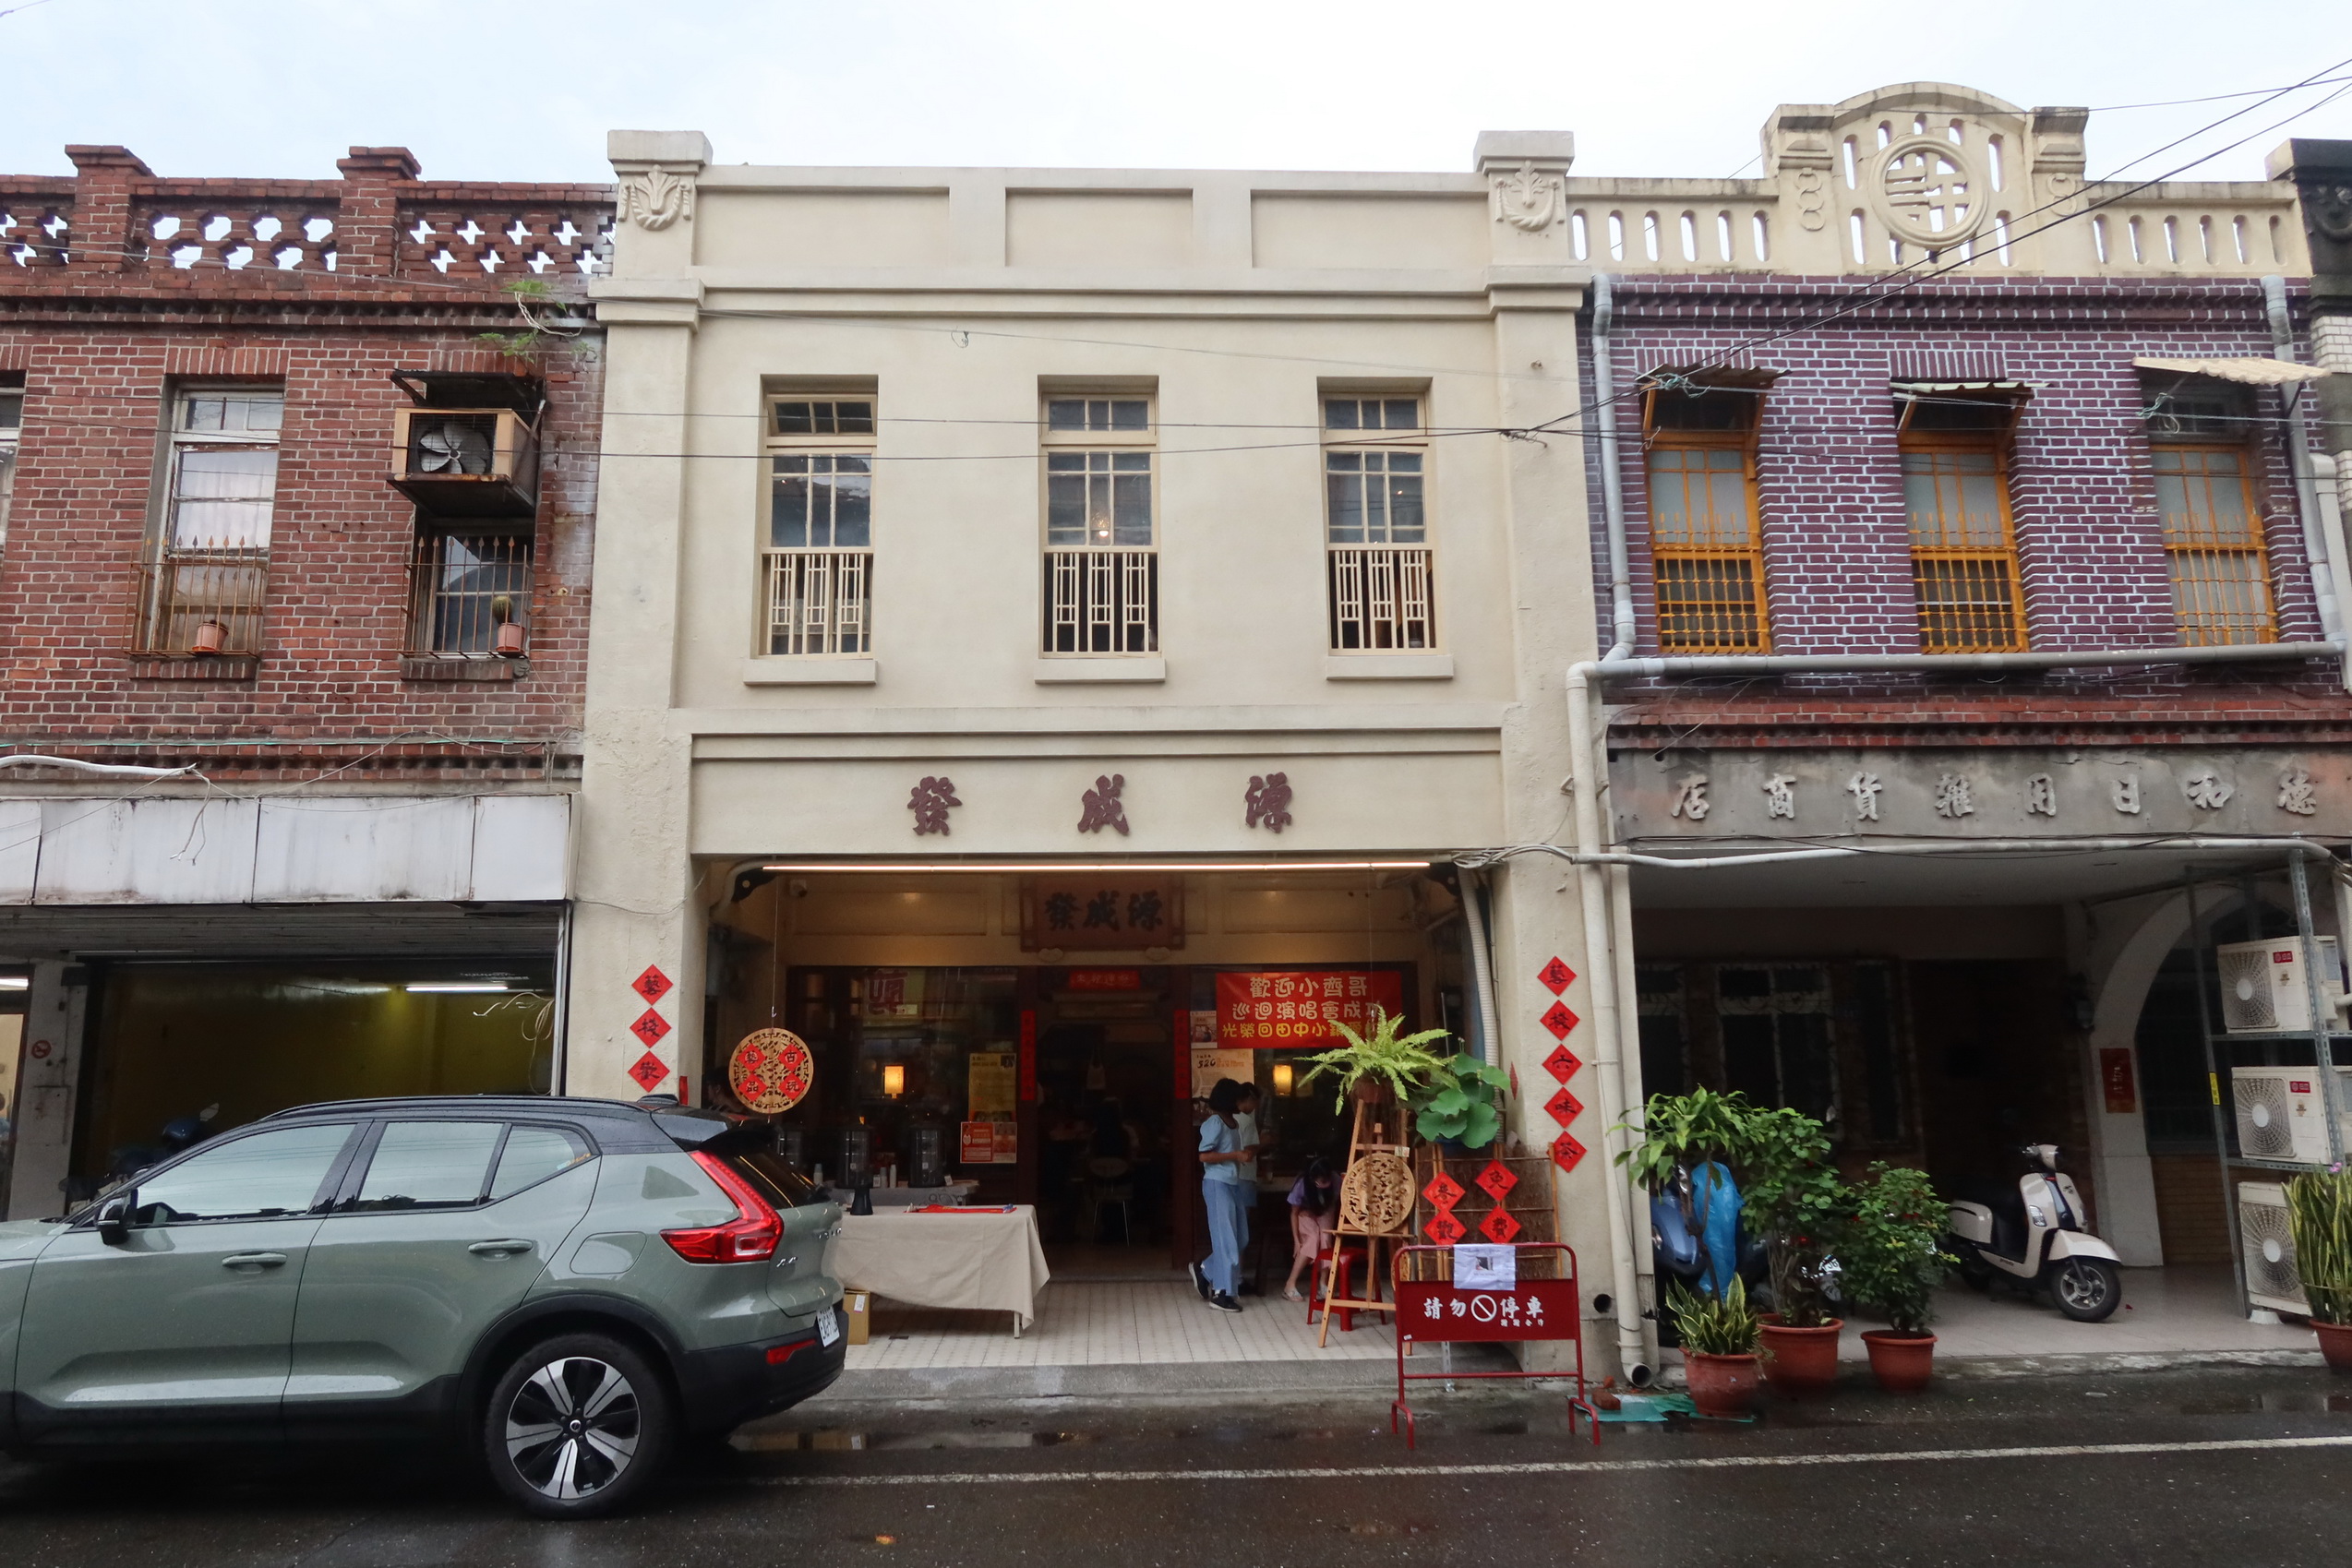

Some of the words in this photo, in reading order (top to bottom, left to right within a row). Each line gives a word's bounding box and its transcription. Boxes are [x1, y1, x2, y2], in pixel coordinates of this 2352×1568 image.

[1250, 976, 1367, 999] 歡迎小齊哥
[1423, 1296, 1466, 1320] 請勿
[1500, 1295, 1543, 1319] 停車
